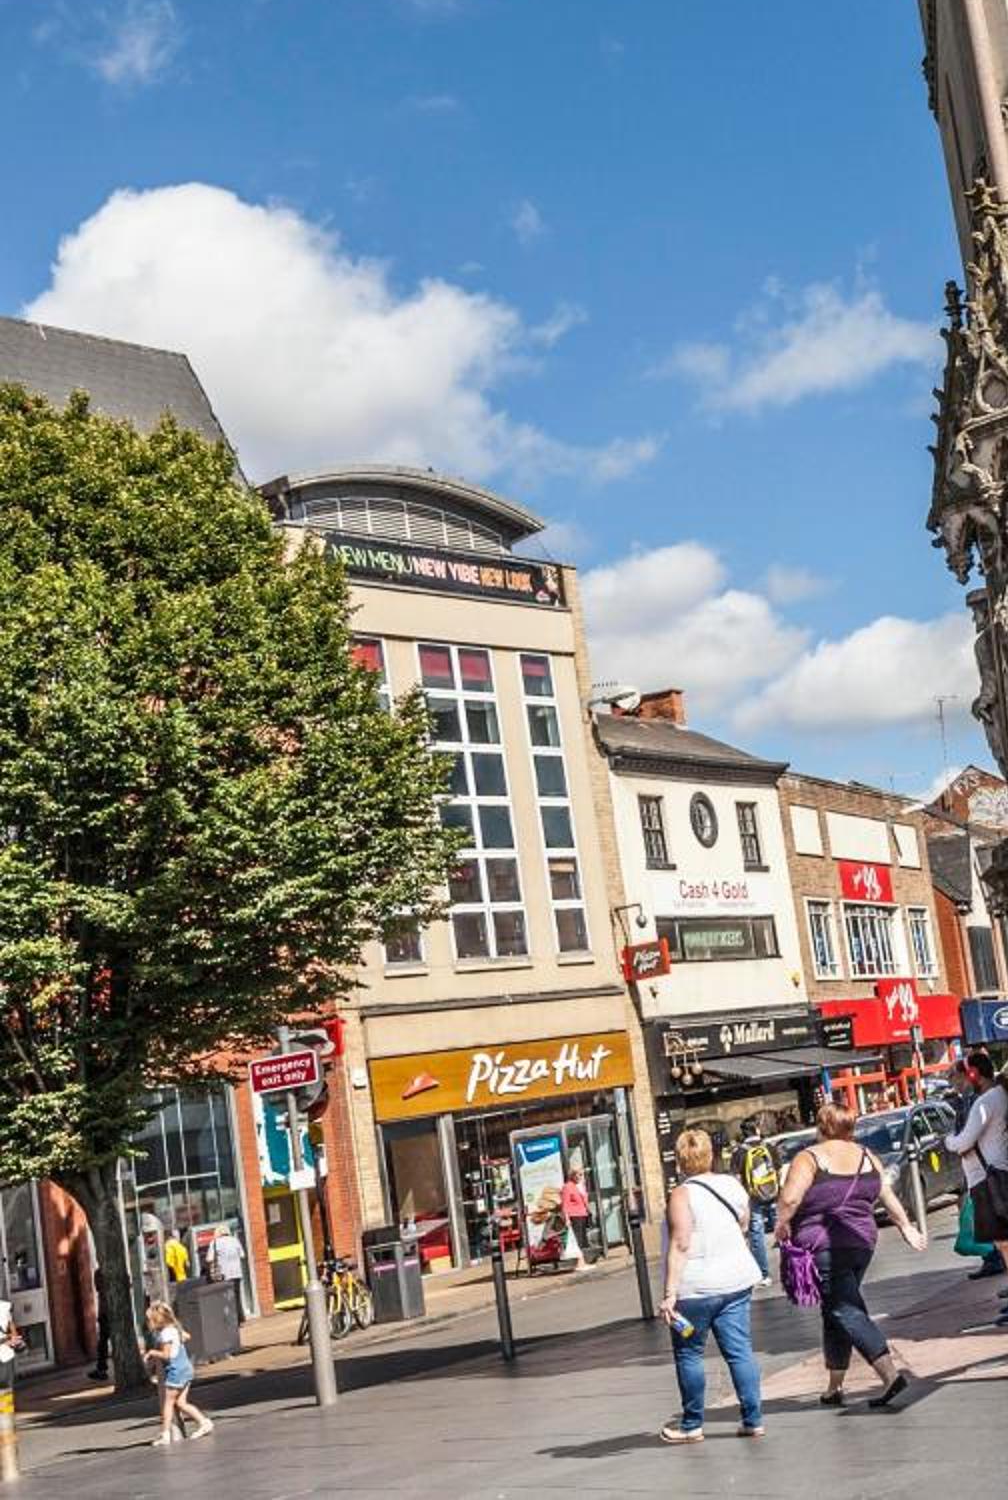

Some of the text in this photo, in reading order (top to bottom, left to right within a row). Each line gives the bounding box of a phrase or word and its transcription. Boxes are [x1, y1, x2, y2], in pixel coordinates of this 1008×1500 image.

[332, 544, 367, 568] NEW
[368, 550, 412, 574] MENU
[412, 556, 446, 580] NEW
[447, 561, 480, 585] VIBE
[680, 880, 748, 899] Cash 4 Gold
[255, 1057, 311, 1075] Emergency
[466, 1043, 612, 1102] Pizza Hut
[261, 1069, 307, 1087] exit only
